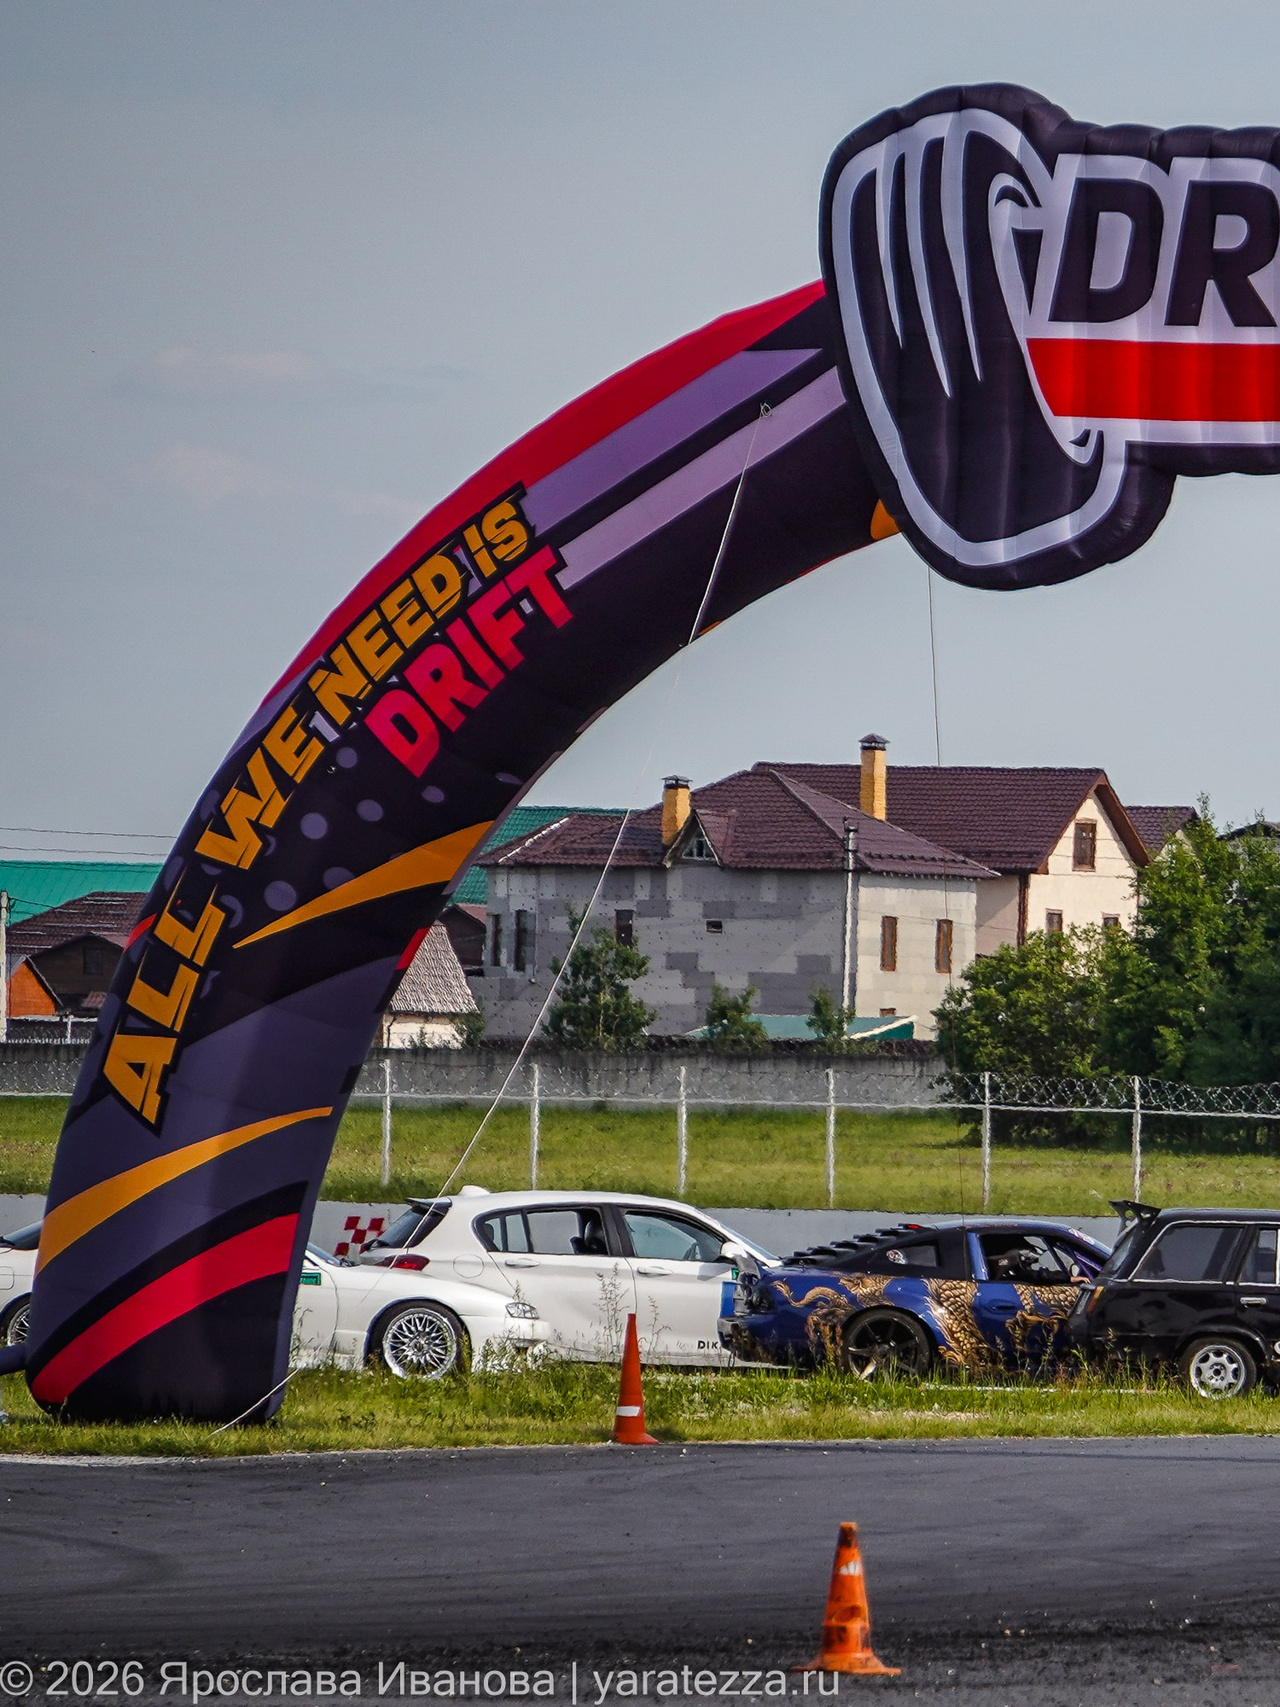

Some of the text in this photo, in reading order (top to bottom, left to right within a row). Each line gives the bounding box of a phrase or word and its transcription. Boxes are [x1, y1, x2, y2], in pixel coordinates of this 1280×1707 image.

[103, 878, 228, 1125] ALL
[196, 704, 326, 870] WE
[308, 552, 463, 725] NEED
[364, 545, 574, 778] DRIFT
